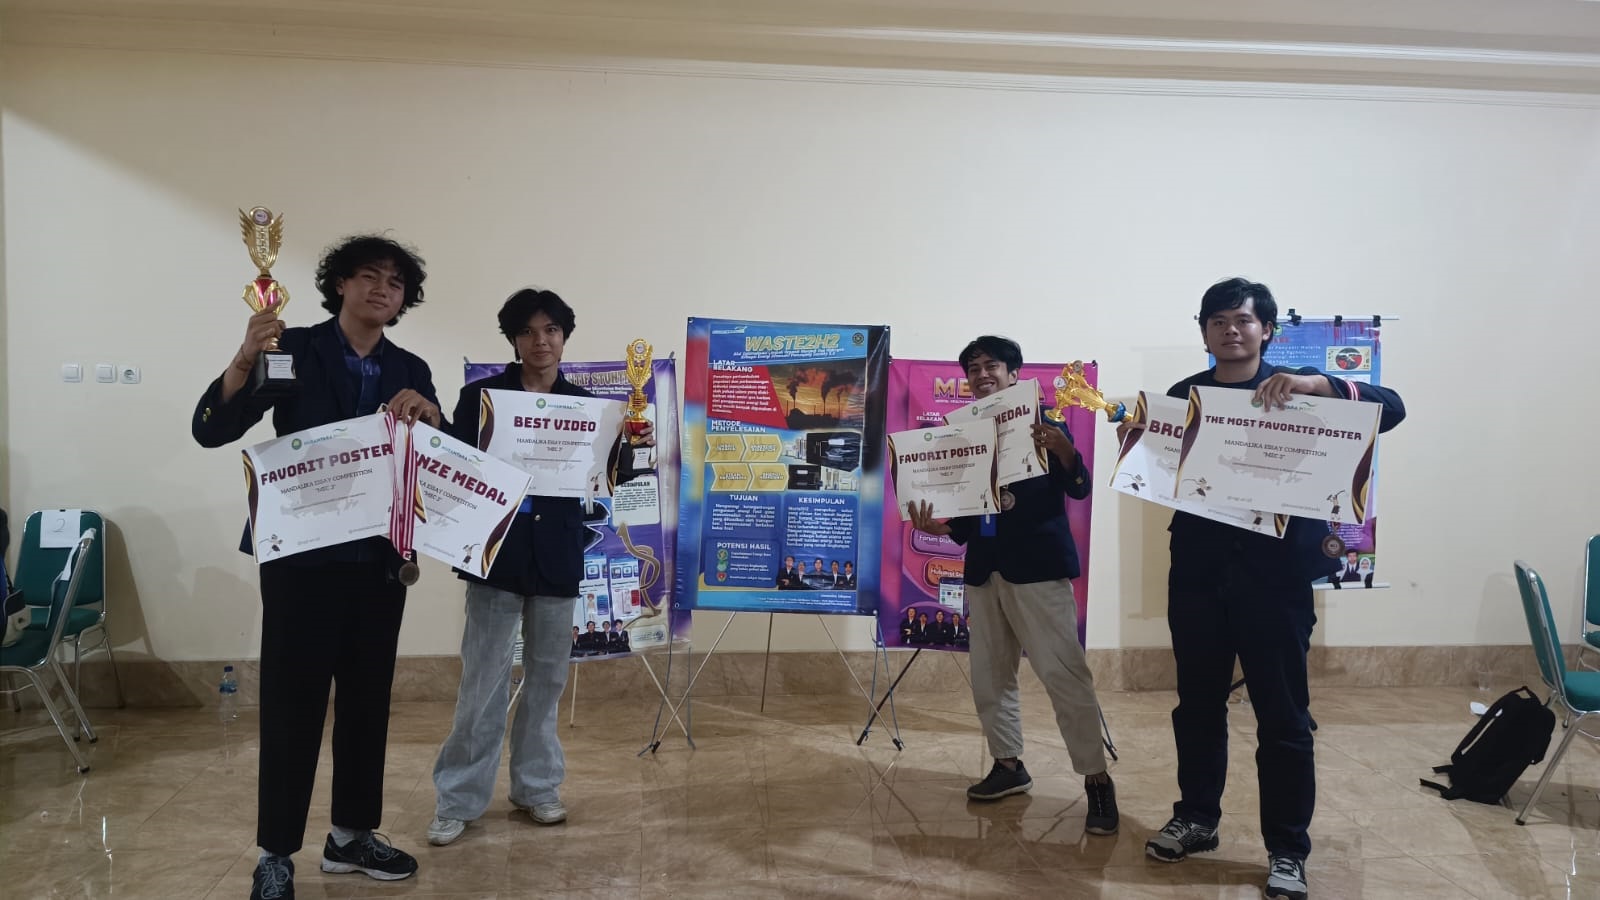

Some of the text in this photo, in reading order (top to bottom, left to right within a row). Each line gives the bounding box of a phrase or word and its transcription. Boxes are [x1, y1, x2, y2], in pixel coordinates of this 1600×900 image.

[745, 334, 840, 352] WASTE2H2
[514, 416, 596, 432] BEST VIDEO
[1205, 415, 1362, 440] THE MOST FAVORITE POSTER
[899, 444, 988, 465] FAVORIT POSTER
[1224, 440, 1263, 449] MANDALIKA
[1284, 447, 1327, 457] COMPETITION
[261, 444, 393, 485] FAVORIT POSTER
[280, 481, 313, 494] MANDALIKA
[332, 468, 373, 482] COMPETITION
[415, 450, 507, 506] NZE MEDAL
[426, 484, 443, 494] ESSAY
[443, 491, 478, 510] COMPETITION
[52, 518, 66, 533] 2
